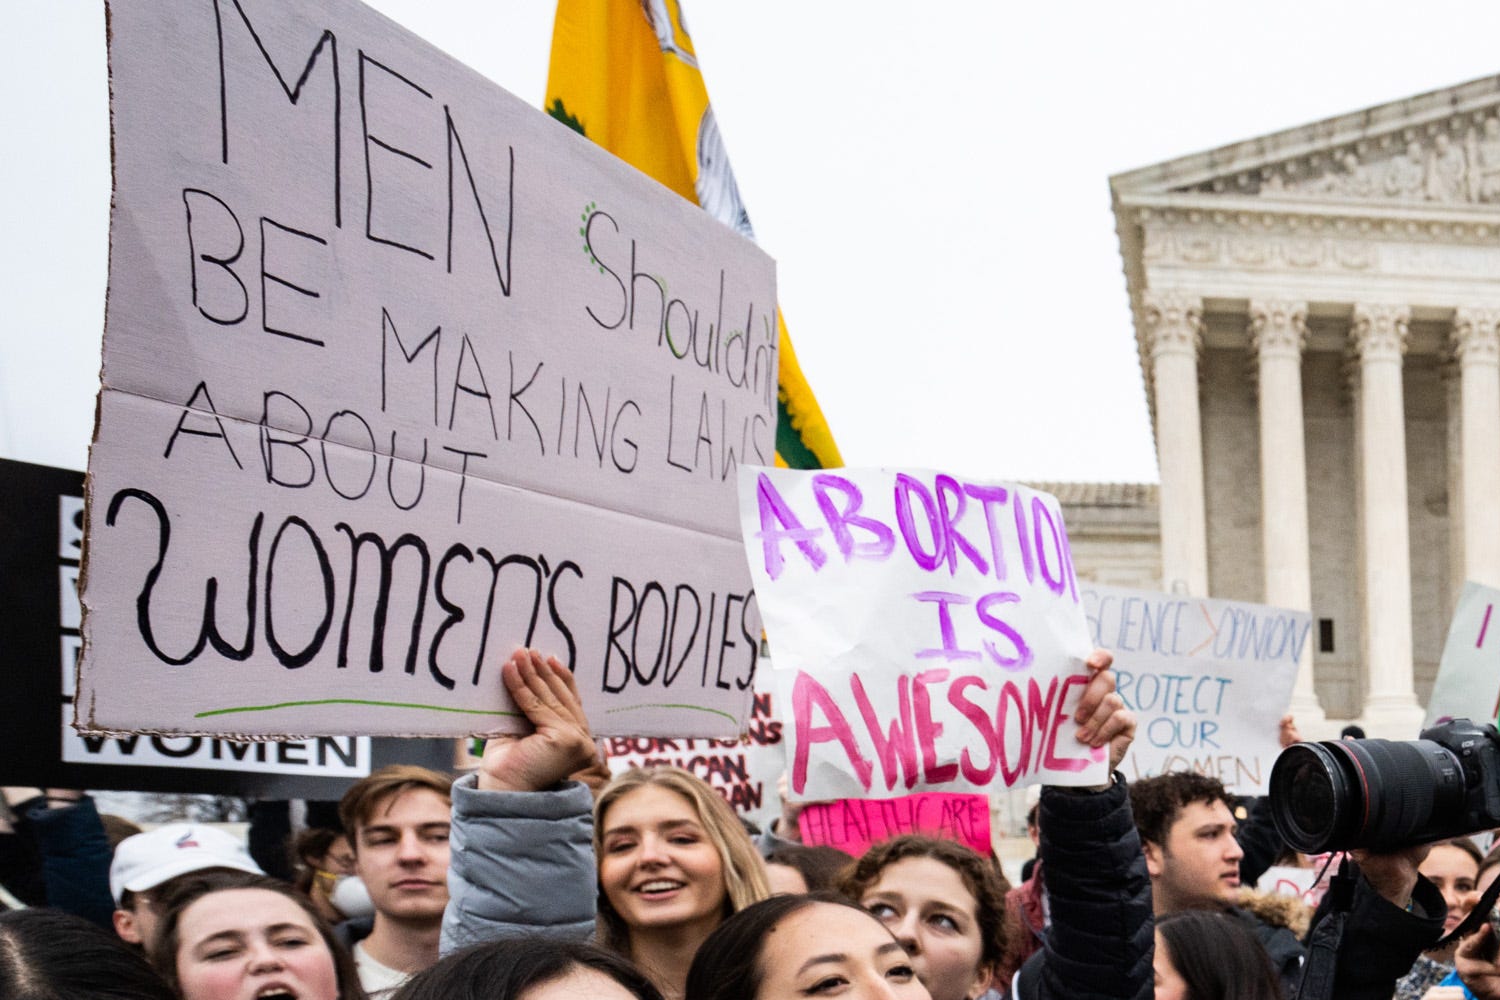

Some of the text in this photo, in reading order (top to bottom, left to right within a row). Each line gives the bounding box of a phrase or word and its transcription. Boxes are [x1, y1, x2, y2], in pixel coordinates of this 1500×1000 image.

[214, 0, 514, 297] MEN
[183, 188, 767, 482] BE MAKING LAWS
[164, 381, 488, 524] ABOUT
[602, 575, 757, 694] BODIES
[912, 590, 1034, 671] IS
[1083, 589, 1189, 657] SCIENCE
[1212, 606, 1312, 664] OPINION
[791, 667, 1106, 796] AWESOME
[1109, 668, 1234, 716] ROTECT
[1147, 716, 1222, 749] OUR
